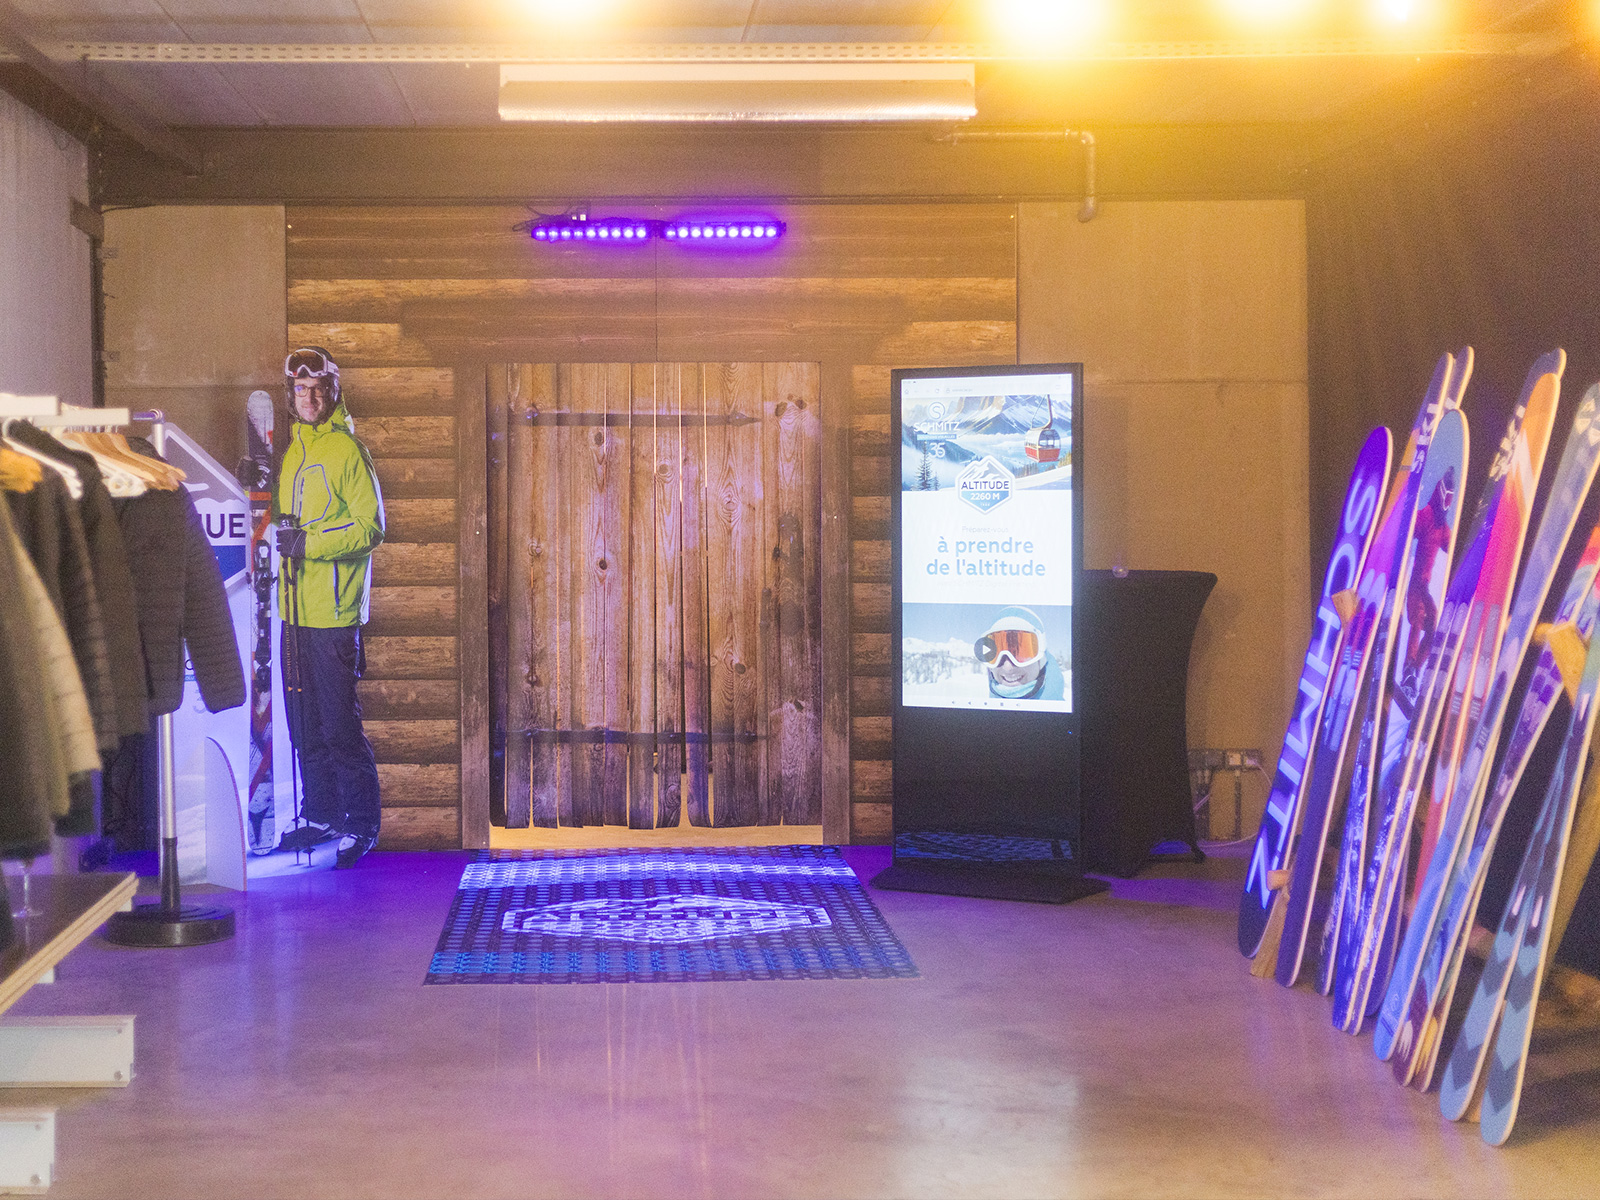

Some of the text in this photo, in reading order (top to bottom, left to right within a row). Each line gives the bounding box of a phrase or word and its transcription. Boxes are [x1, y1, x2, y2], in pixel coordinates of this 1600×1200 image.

[913, 421, 961, 432] SCHMITZ
[961, 480, 1010, 490] ALTITUDE
[970, 492, 1000, 501] 2260 M
[198, 513, 246, 539] UE
[961, 525, 1010, 534] Préparez-vous
[937, 535, 1034, 557] à prendre
[926, 558, 1046, 577] de l'altitude
